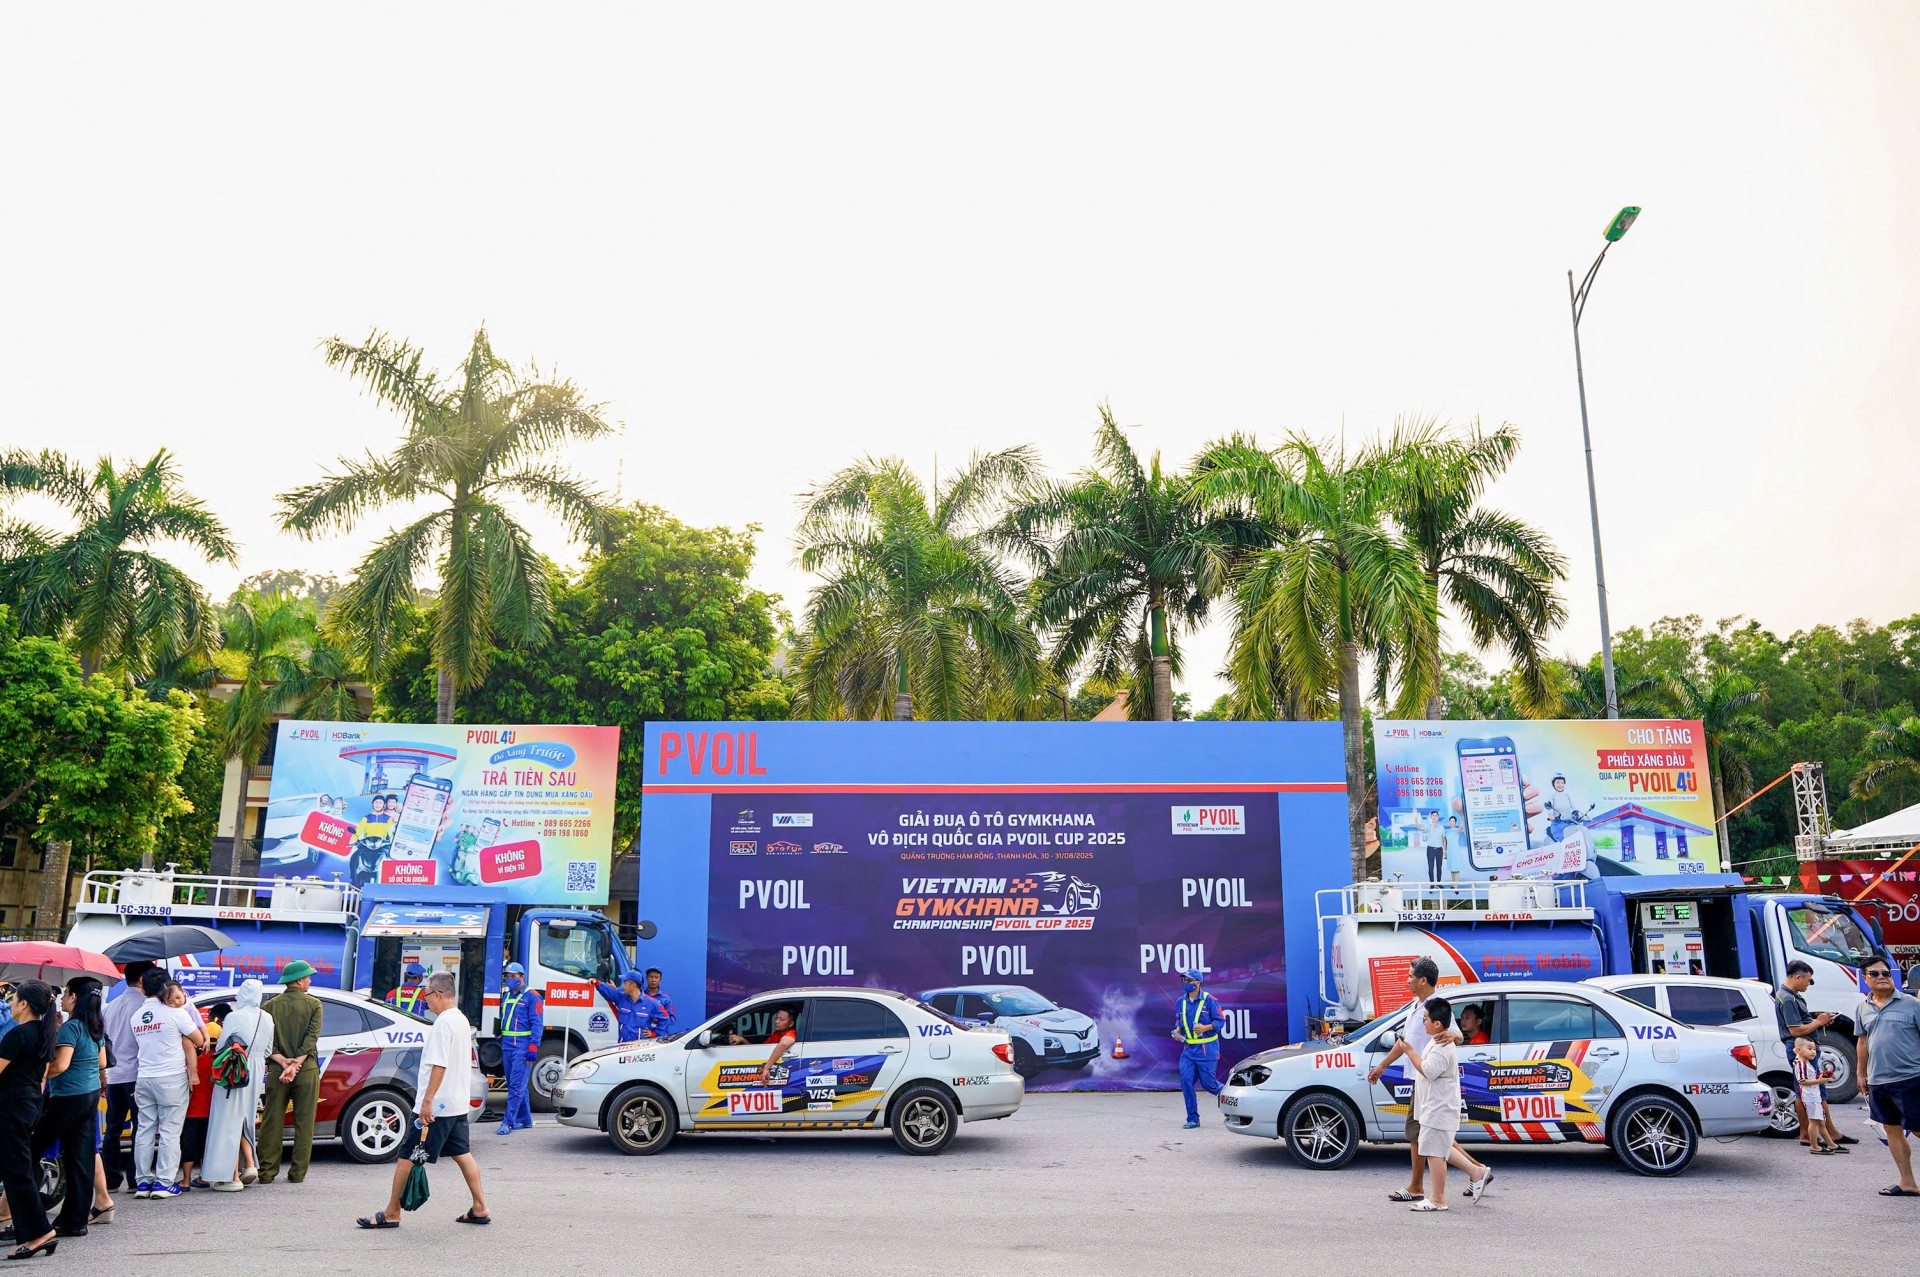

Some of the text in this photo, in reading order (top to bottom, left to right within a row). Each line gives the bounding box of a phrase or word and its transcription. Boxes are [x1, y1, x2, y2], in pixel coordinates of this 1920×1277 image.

[300, 729, 320, 740] PVOIL
[331, 731, 361, 740] HDBank
[466, 730, 516, 745] PVOIL4U
[1392, 728, 1410, 737] PVOIL
[1627, 726, 1692, 747] CHO TẶNG
[529, 744, 566, 763] Trước
[659, 732, 767, 776] PVOIL
[1607, 751, 1686, 767] PHIẾU XĂNG DẦU
[1395, 764, 1420, 773] Hotline
[482, 766, 577, 787] TRẢ TIỀN SAU
[1395, 777, 1443, 786] 089 665 2266
[1598, 771, 1698, 793] QUA APP PVOIL4U
[461, 789, 479, 798] NGÂN
[480, 789, 498, 798] HÀNG
[560, 790, 578, 799] XĂNG
[1396, 789, 1443, 797] 096 198 1860
[898, 810, 1096, 827] GIẢI ĐUA Ô TÔ GYMKHANA
[1199, 808, 1240, 826] PVOIL
[318, 821, 345, 838] KHÔNG
[511, 819, 591, 829] Hotline 089 665 2266
[543, 829, 589, 838] 096 198 1860
[867, 827, 1126, 849] VÔ ĐỊCH QUỐC GIA PVOIL CUP 2025
[494, 849, 526, 864] KHÔNG
[956, 850, 973, 860] HÀM
[1055, 852, 1094, 860] 31/08/2025
[394, 863, 423, 875] KHÔNG
[1516, 859, 1533, 868] CHO
[901, 878, 1007, 894] VIETNAM
[739, 879, 810, 910] PVOIL
[1182, 878, 1253, 908] PVOIL
[114, 904, 172, 916] 15C-333.90
[895, 897, 1039, 916] GYMKHANA
[1887, 894, 1920, 922] ĐỔ
[218, 908, 247, 920] CẤM
[1397, 912, 1446, 921] 15C-332.47
[1484, 911, 1509, 921] CẤM
[893, 919, 1092, 930] CHAMPIONSHIP PVOIL CUP 2025
[213, 954, 269, 973] PVOIL
[782, 945, 854, 976] PVOIL
[962, 945, 1034, 976] PVOIL
[1140, 944, 1211, 974] PVOIL
[1482, 953, 1592, 971] PVOIL Mobile
[257, 971, 269, 981] gần
[550, 989, 590, 1000] RON 95-III
[1220, 1009, 1258, 1039] OIL
[915, 1024, 953, 1037] VISA
[1630, 1025, 1678, 1040] VISA
[385, 1032, 425, 1044] VISA
[619, 1055, 632, 1064] UR
[1315, 1052, 1356, 1069] PVOIL
[721, 1067, 758, 1075] VIETNAM
[1490, 1068, 1533, 1077] VIETNAM
[719, 1074, 764, 1083] GYMKHAN
[952, 1077, 966, 1086] UR
[1489, 1075, 1547, 1085] GYMKHANA
[806, 1089, 836, 1100] VISA
[1683, 1083, 1700, 1095] UR
[730, 1092, 780, 1113] PVOIL
[1503, 1096, 1562, 1120] PVOIL
